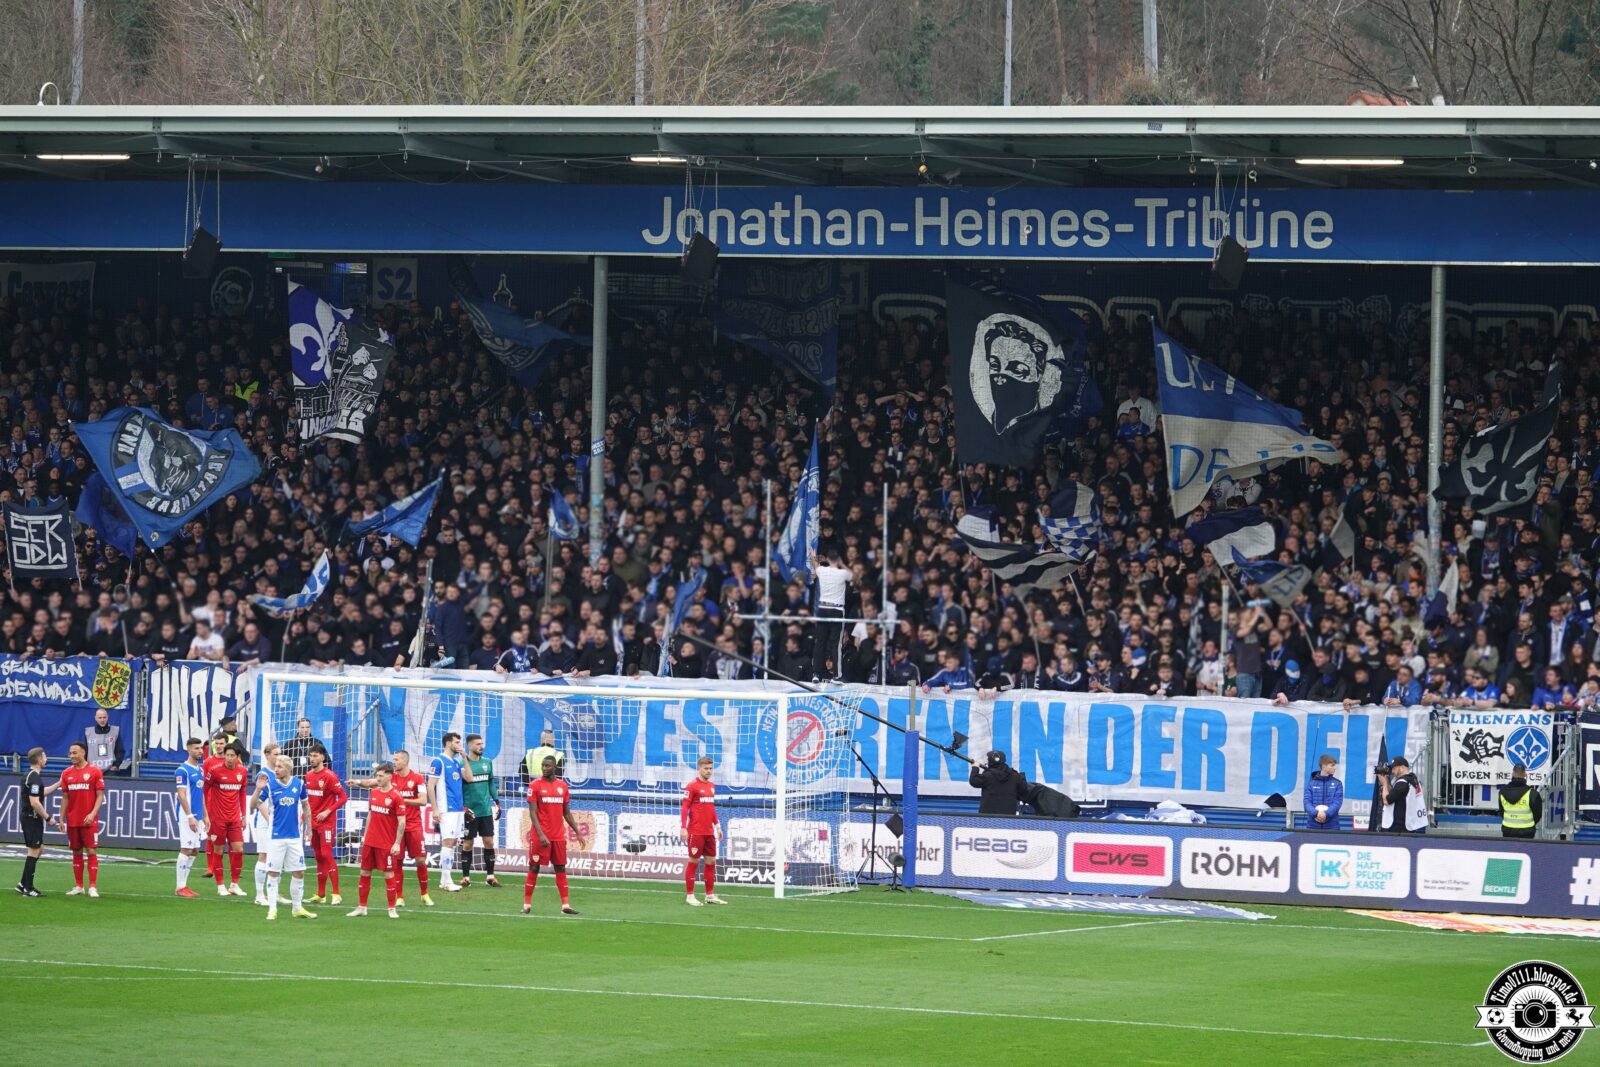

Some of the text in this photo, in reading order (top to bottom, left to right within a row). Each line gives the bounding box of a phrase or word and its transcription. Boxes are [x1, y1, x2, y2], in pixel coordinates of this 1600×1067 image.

[641, 194, 1334, 249] Jonathan-Heimes-Tribüne
[377, 267, 413, 300] S2
[1450, 713, 1551, 726] LILIENFANS
[990, 700, 1067, 785] IN
[1086, 703, 1228, 793] DER
[1454, 770, 1491, 780] GEGEN
[1088, 851, 1149, 868] CWS
[1191, 846, 1280, 878] RÖHM
[1356, 852, 1372, 860] DIE
[594, 858, 685, 875] STEUERUNG
[1356, 862, 1381, 870] HAFT
[1356, 871, 1394, 880] PFLICHT
[1356, 881, 1386, 890] KASSE
[1483, 885, 1517, 894] BECHTLE
